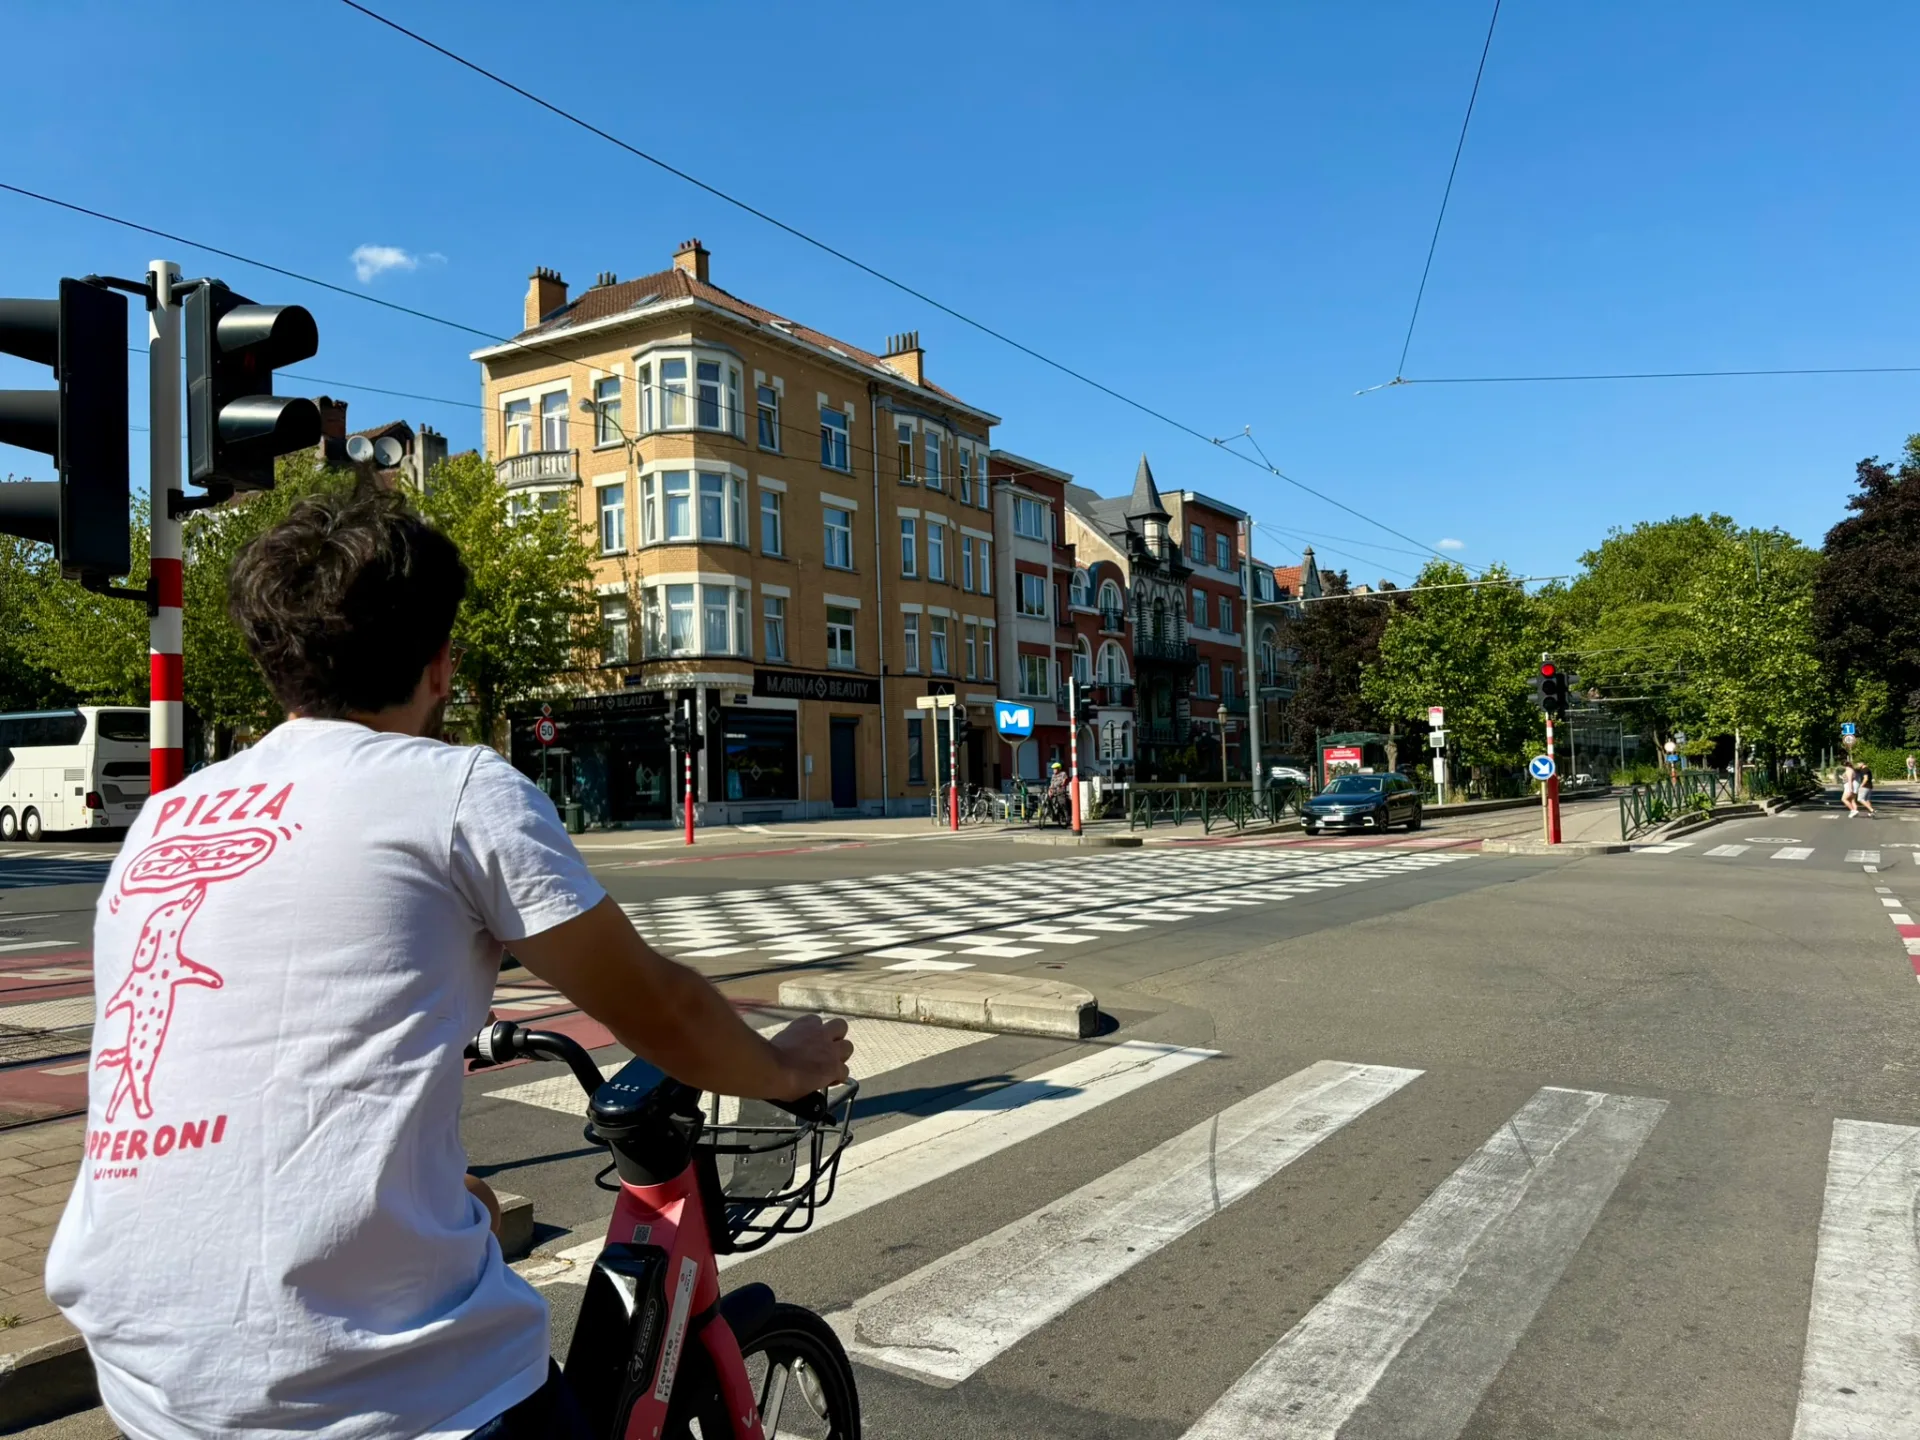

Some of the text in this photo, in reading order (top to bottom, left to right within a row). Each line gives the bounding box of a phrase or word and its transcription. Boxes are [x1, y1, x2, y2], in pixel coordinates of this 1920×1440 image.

[766, 675, 869, 698] MARINA BEAUTY
[616, 694, 654, 708] BEAUTY
[1000, 709, 1030, 729] M
[541, 724, 553, 736] 50
[151, 782, 295, 838] PIZZA
[656, 1339, 674, 1395] Eerste
